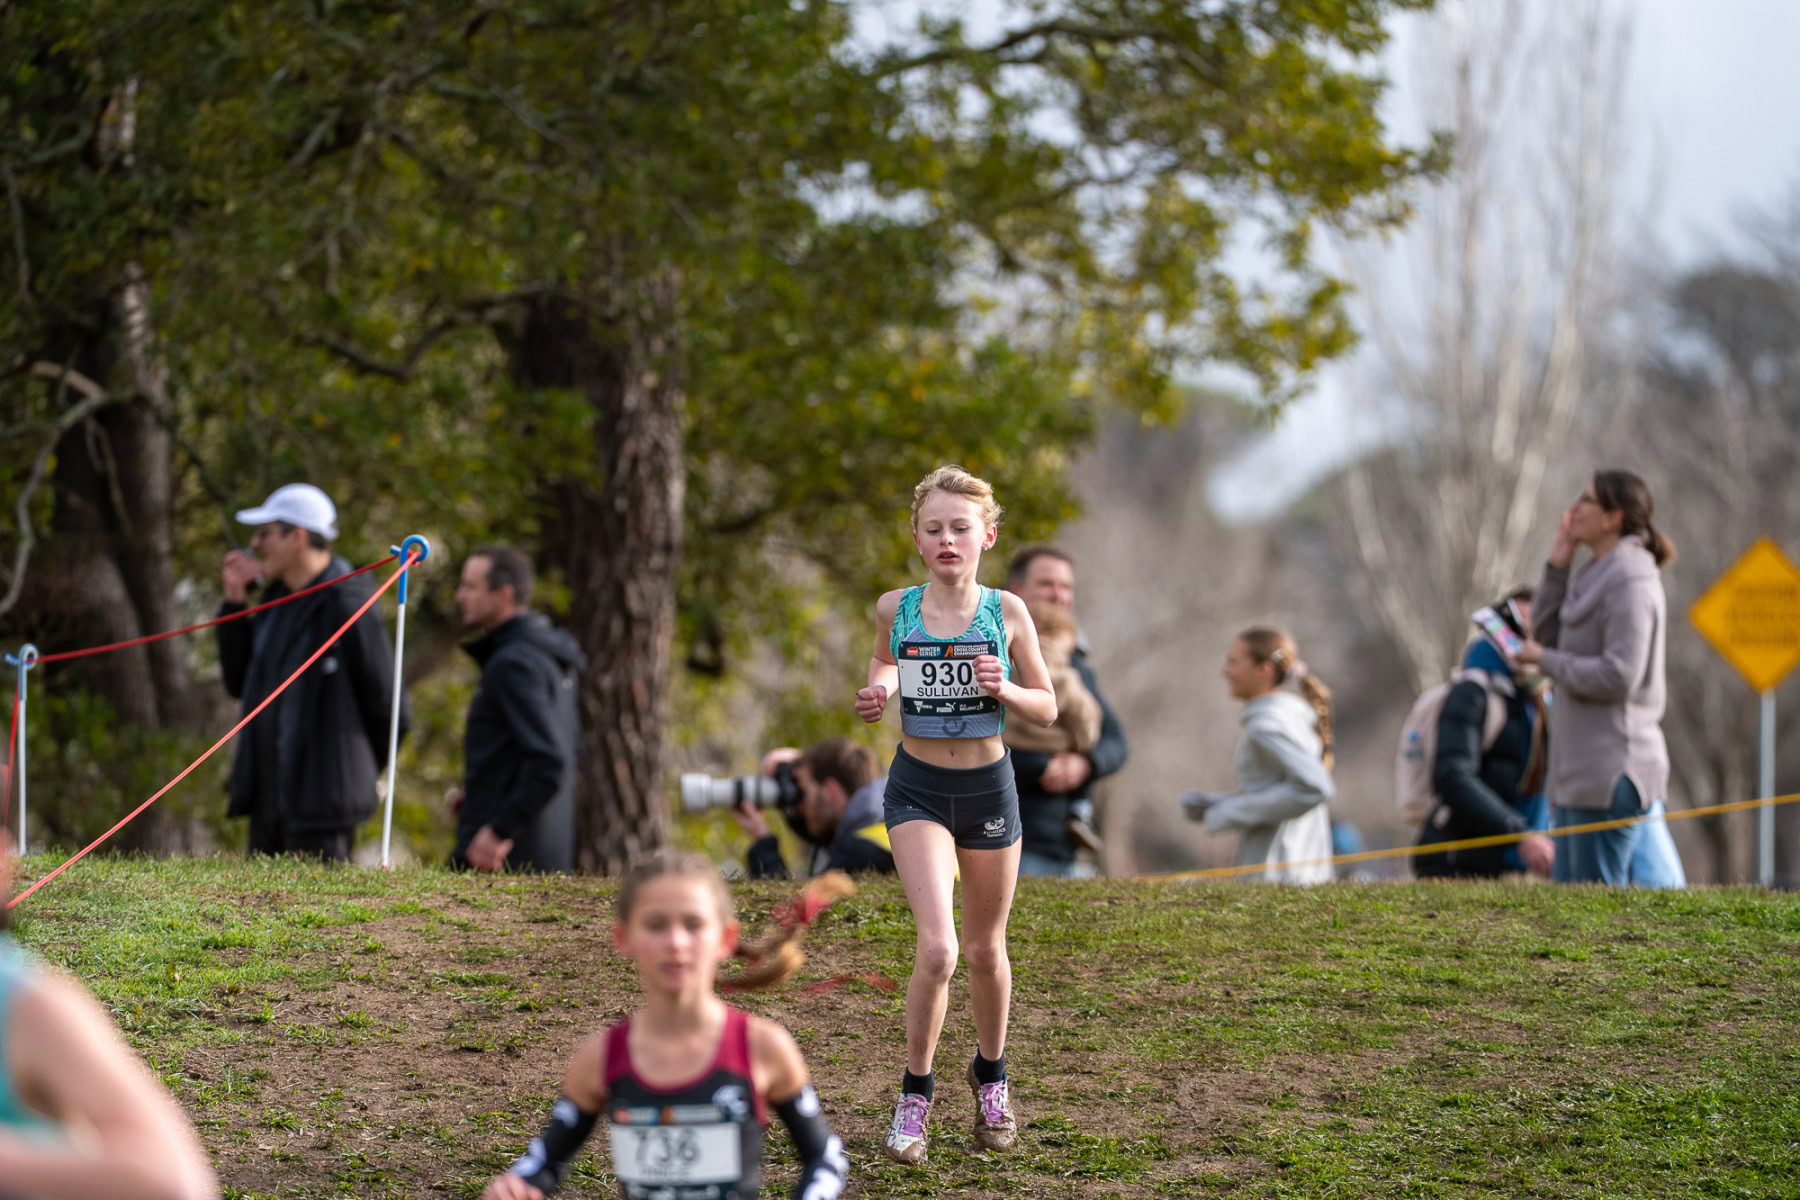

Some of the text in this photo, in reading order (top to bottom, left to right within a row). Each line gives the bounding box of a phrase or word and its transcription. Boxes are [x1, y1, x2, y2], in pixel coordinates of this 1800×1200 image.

[921, 662, 972, 686] 930
[917, 686, 978, 697] SULLIVAN
[631, 1127, 700, 1166] 736
